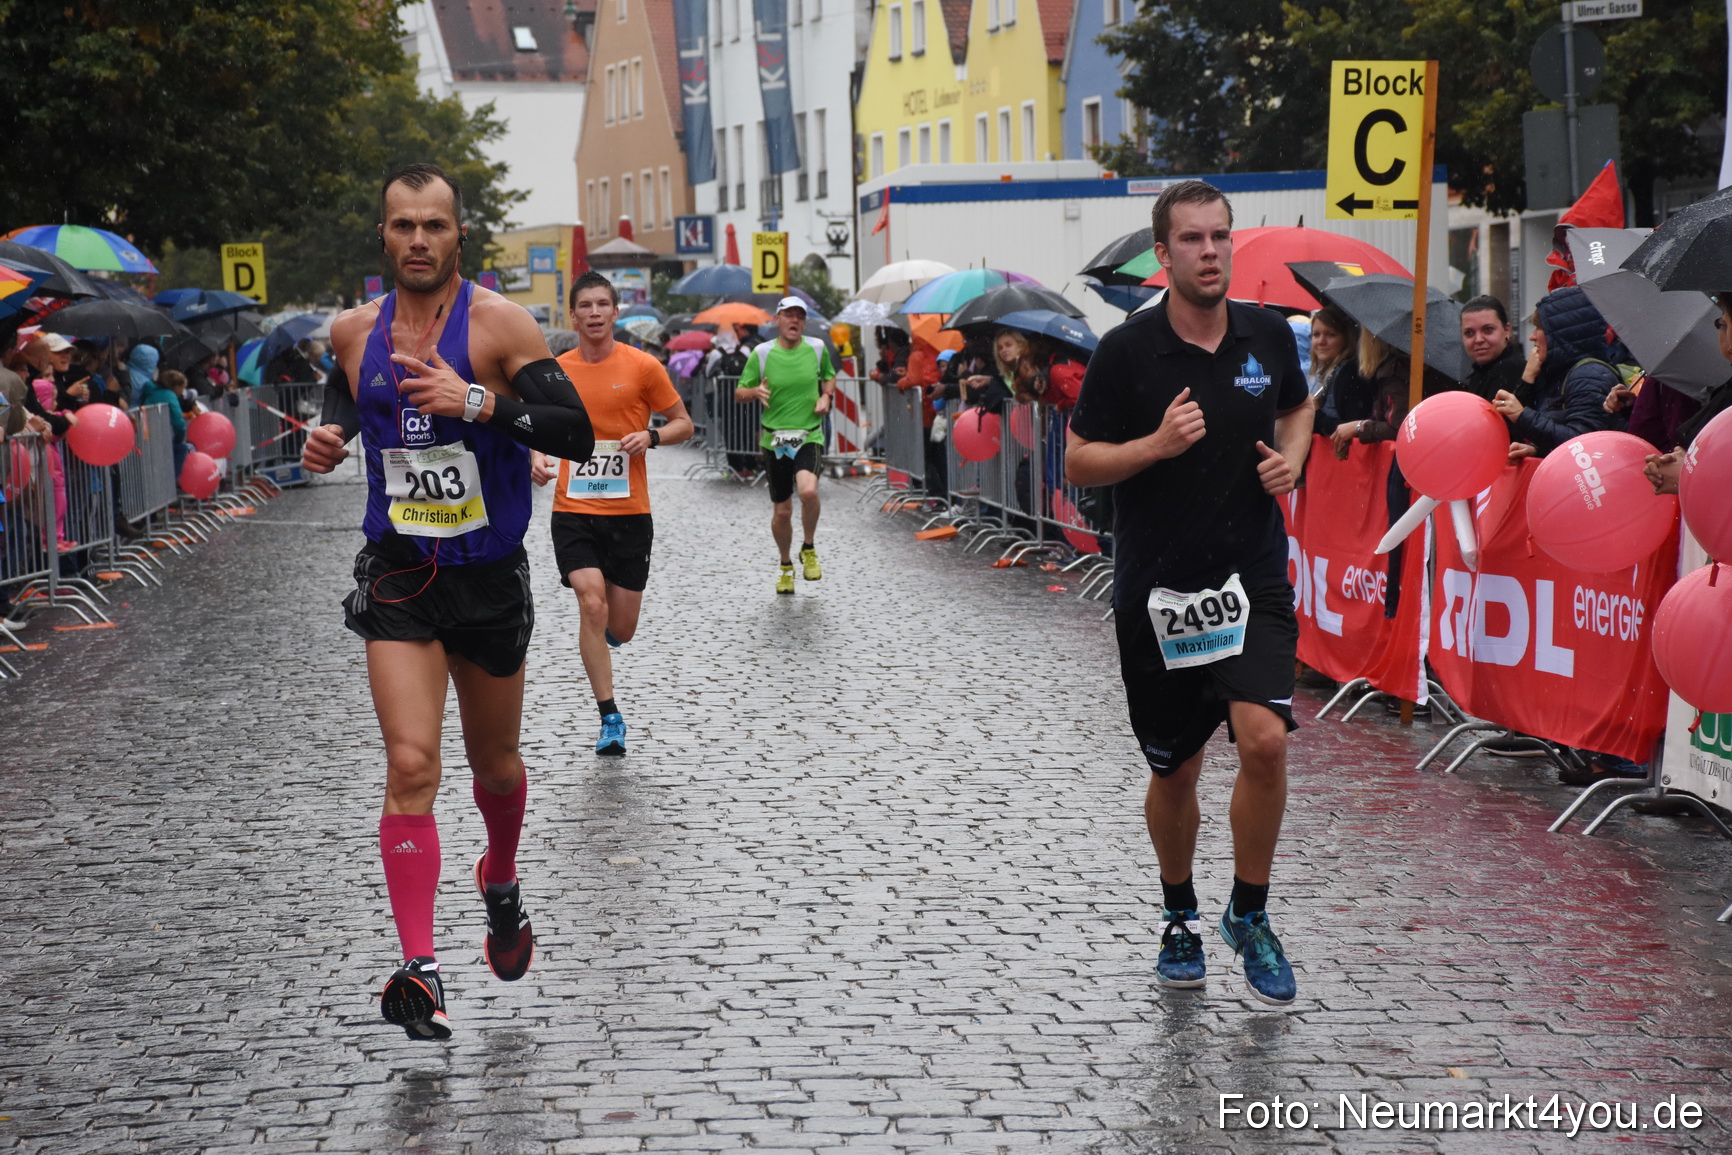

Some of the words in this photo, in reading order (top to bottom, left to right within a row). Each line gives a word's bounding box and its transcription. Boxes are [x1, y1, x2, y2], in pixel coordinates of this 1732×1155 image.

[1577, 5, 1605, 17] Ulmer
[1609, 2, 1637, 14] Gasse
[1344, 68, 1424, 96] Block
[1354, 108, 1408, 186] C
[756, 234, 785, 246] Block
[226, 246, 259, 258] Block
[762, 250, 779, 279] D
[234, 262, 255, 291] D
[1235, 376, 1271, 385] FIBALON
[406, 413, 431, 432] a3
[513, 420, 534, 433] adidas
[406, 431, 431, 442] sports
[576, 454, 624, 477] 2573
[1568, 441, 1606, 508] RÖDL
[405, 466, 466, 502] 203
[587, 481, 608, 491] Peter
[402, 507, 458, 524] Christian
[461, 506, 472, 520] K.
[1160, 591, 1242, 636] 2499
[1175, 633, 1235, 655] Maximilian
